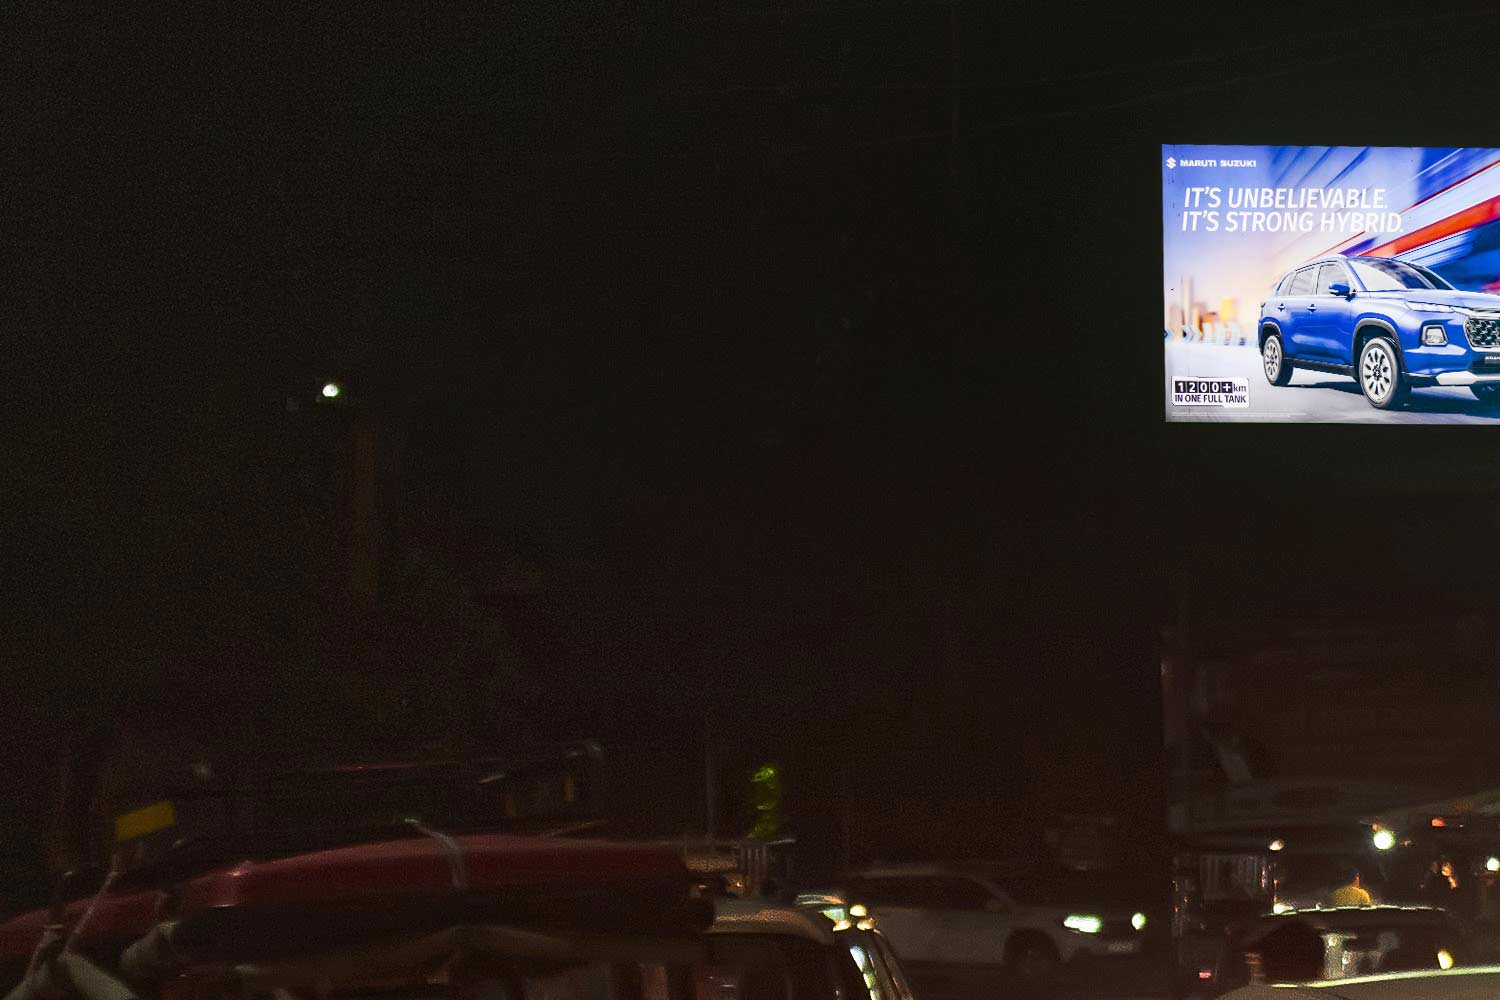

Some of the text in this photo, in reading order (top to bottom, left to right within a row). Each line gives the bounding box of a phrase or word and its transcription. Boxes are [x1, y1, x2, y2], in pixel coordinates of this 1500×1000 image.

[1180, 159, 1257, 168] MARUTI SUZUKI
[1184, 187, 1388, 209] IT'S UNBELIEVABLE.
[1181, 211, 1220, 232] IT'S
[1225, 211, 1313, 233] STRONG
[1185, 395, 1201, 403] ONE
[1203, 395, 1223, 403] FULL
